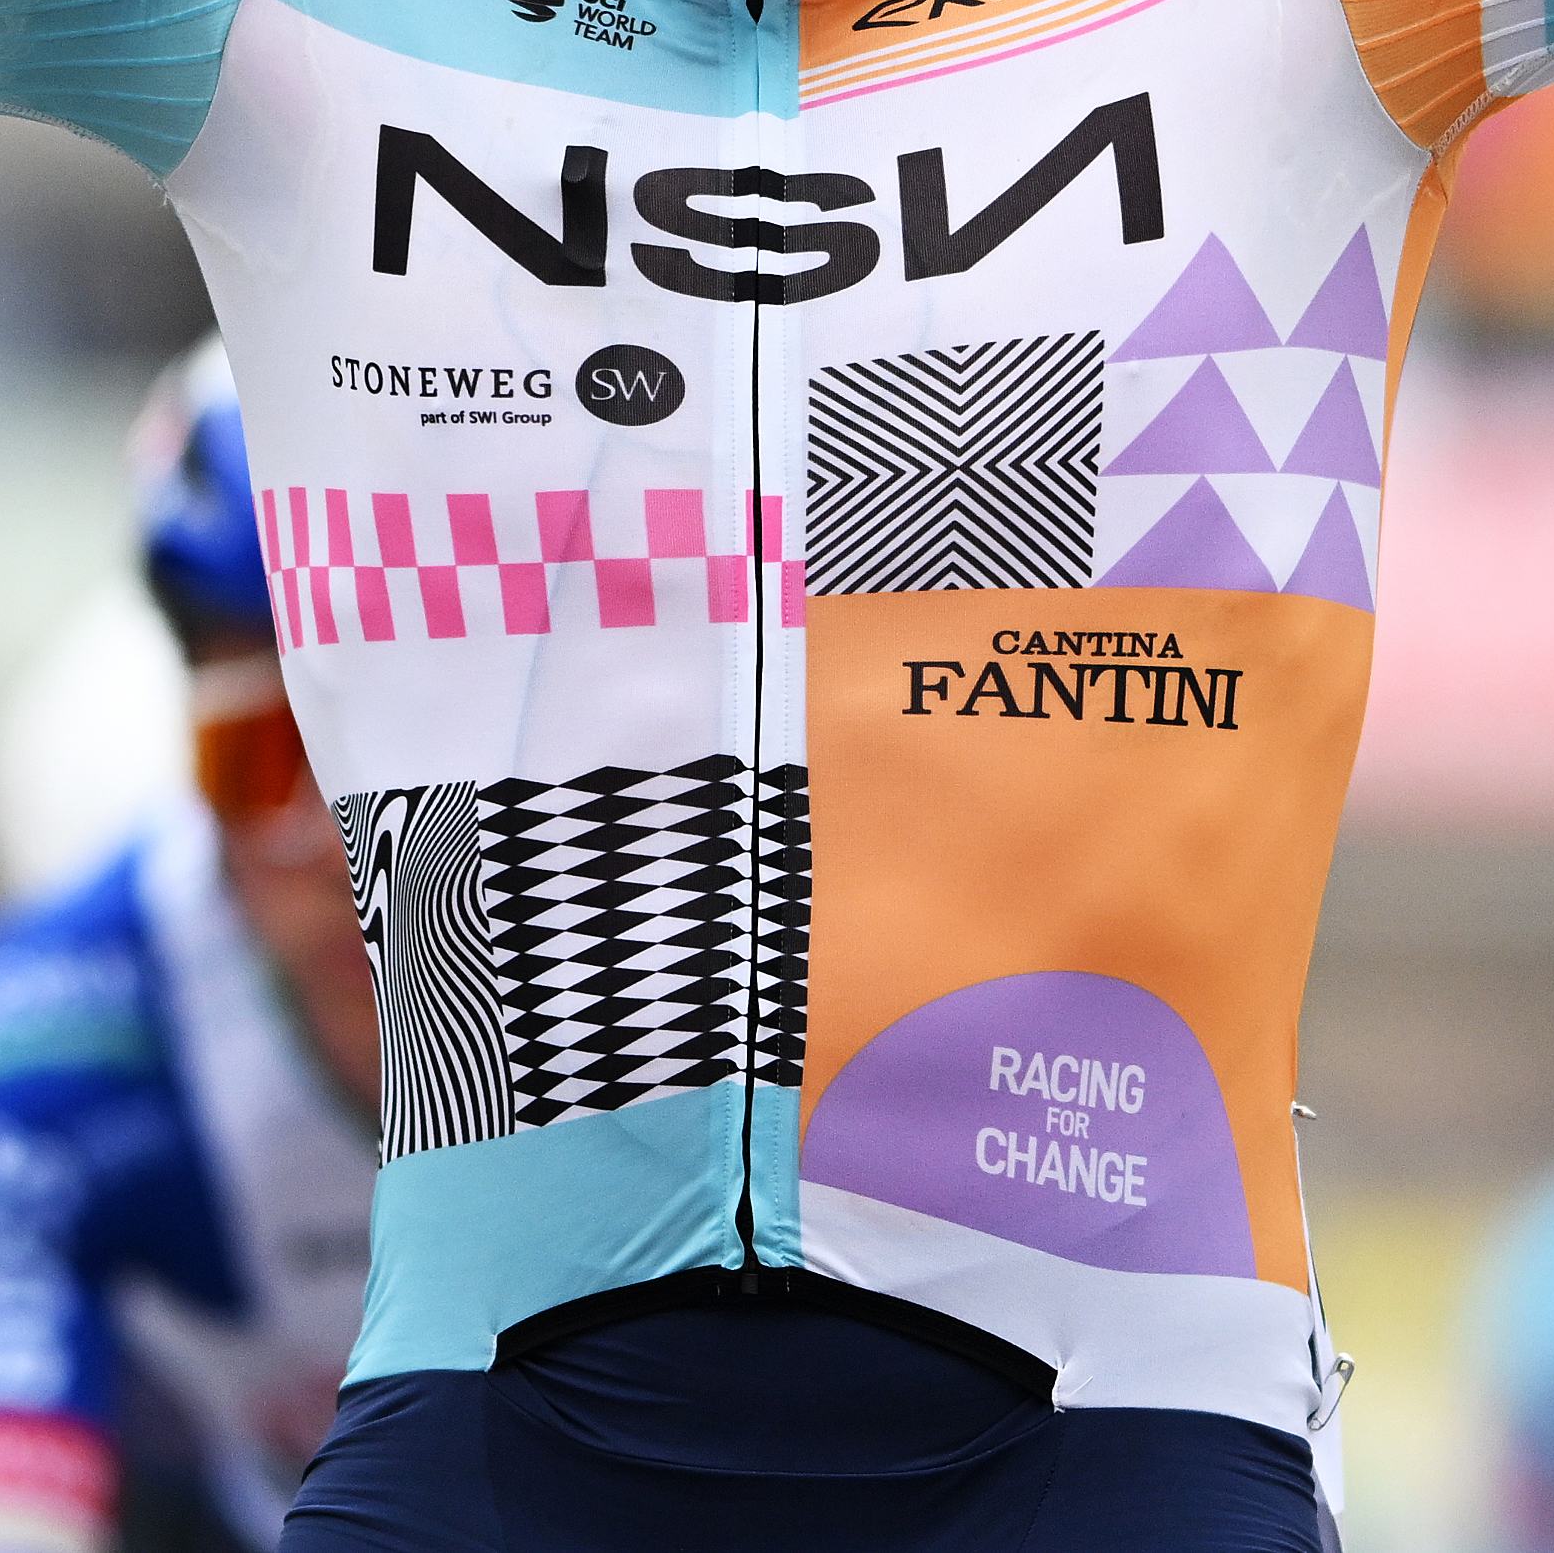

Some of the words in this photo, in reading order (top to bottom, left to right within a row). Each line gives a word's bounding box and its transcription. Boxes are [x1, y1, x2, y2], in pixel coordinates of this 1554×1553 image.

[573, 19, 634, 51] TEAM
[578, 3, 657, 36] WORLD
[330, 354, 553, 399] STONEWEG
[590, 367, 667, 403] SW
[420, 411, 447, 427] part
[450, 410, 466, 424] of
[468, 410, 497, 424] SWI
[501, 410, 553, 427] Group
[991, 629, 1184, 659] CANTINA
[901, 661, 1244, 730] FANTINI
[988, 1046, 1146, 1114] RACING
[1045, 1106, 1091, 1140] FOR
[975, 1127, 1148, 1207] CHANGE
